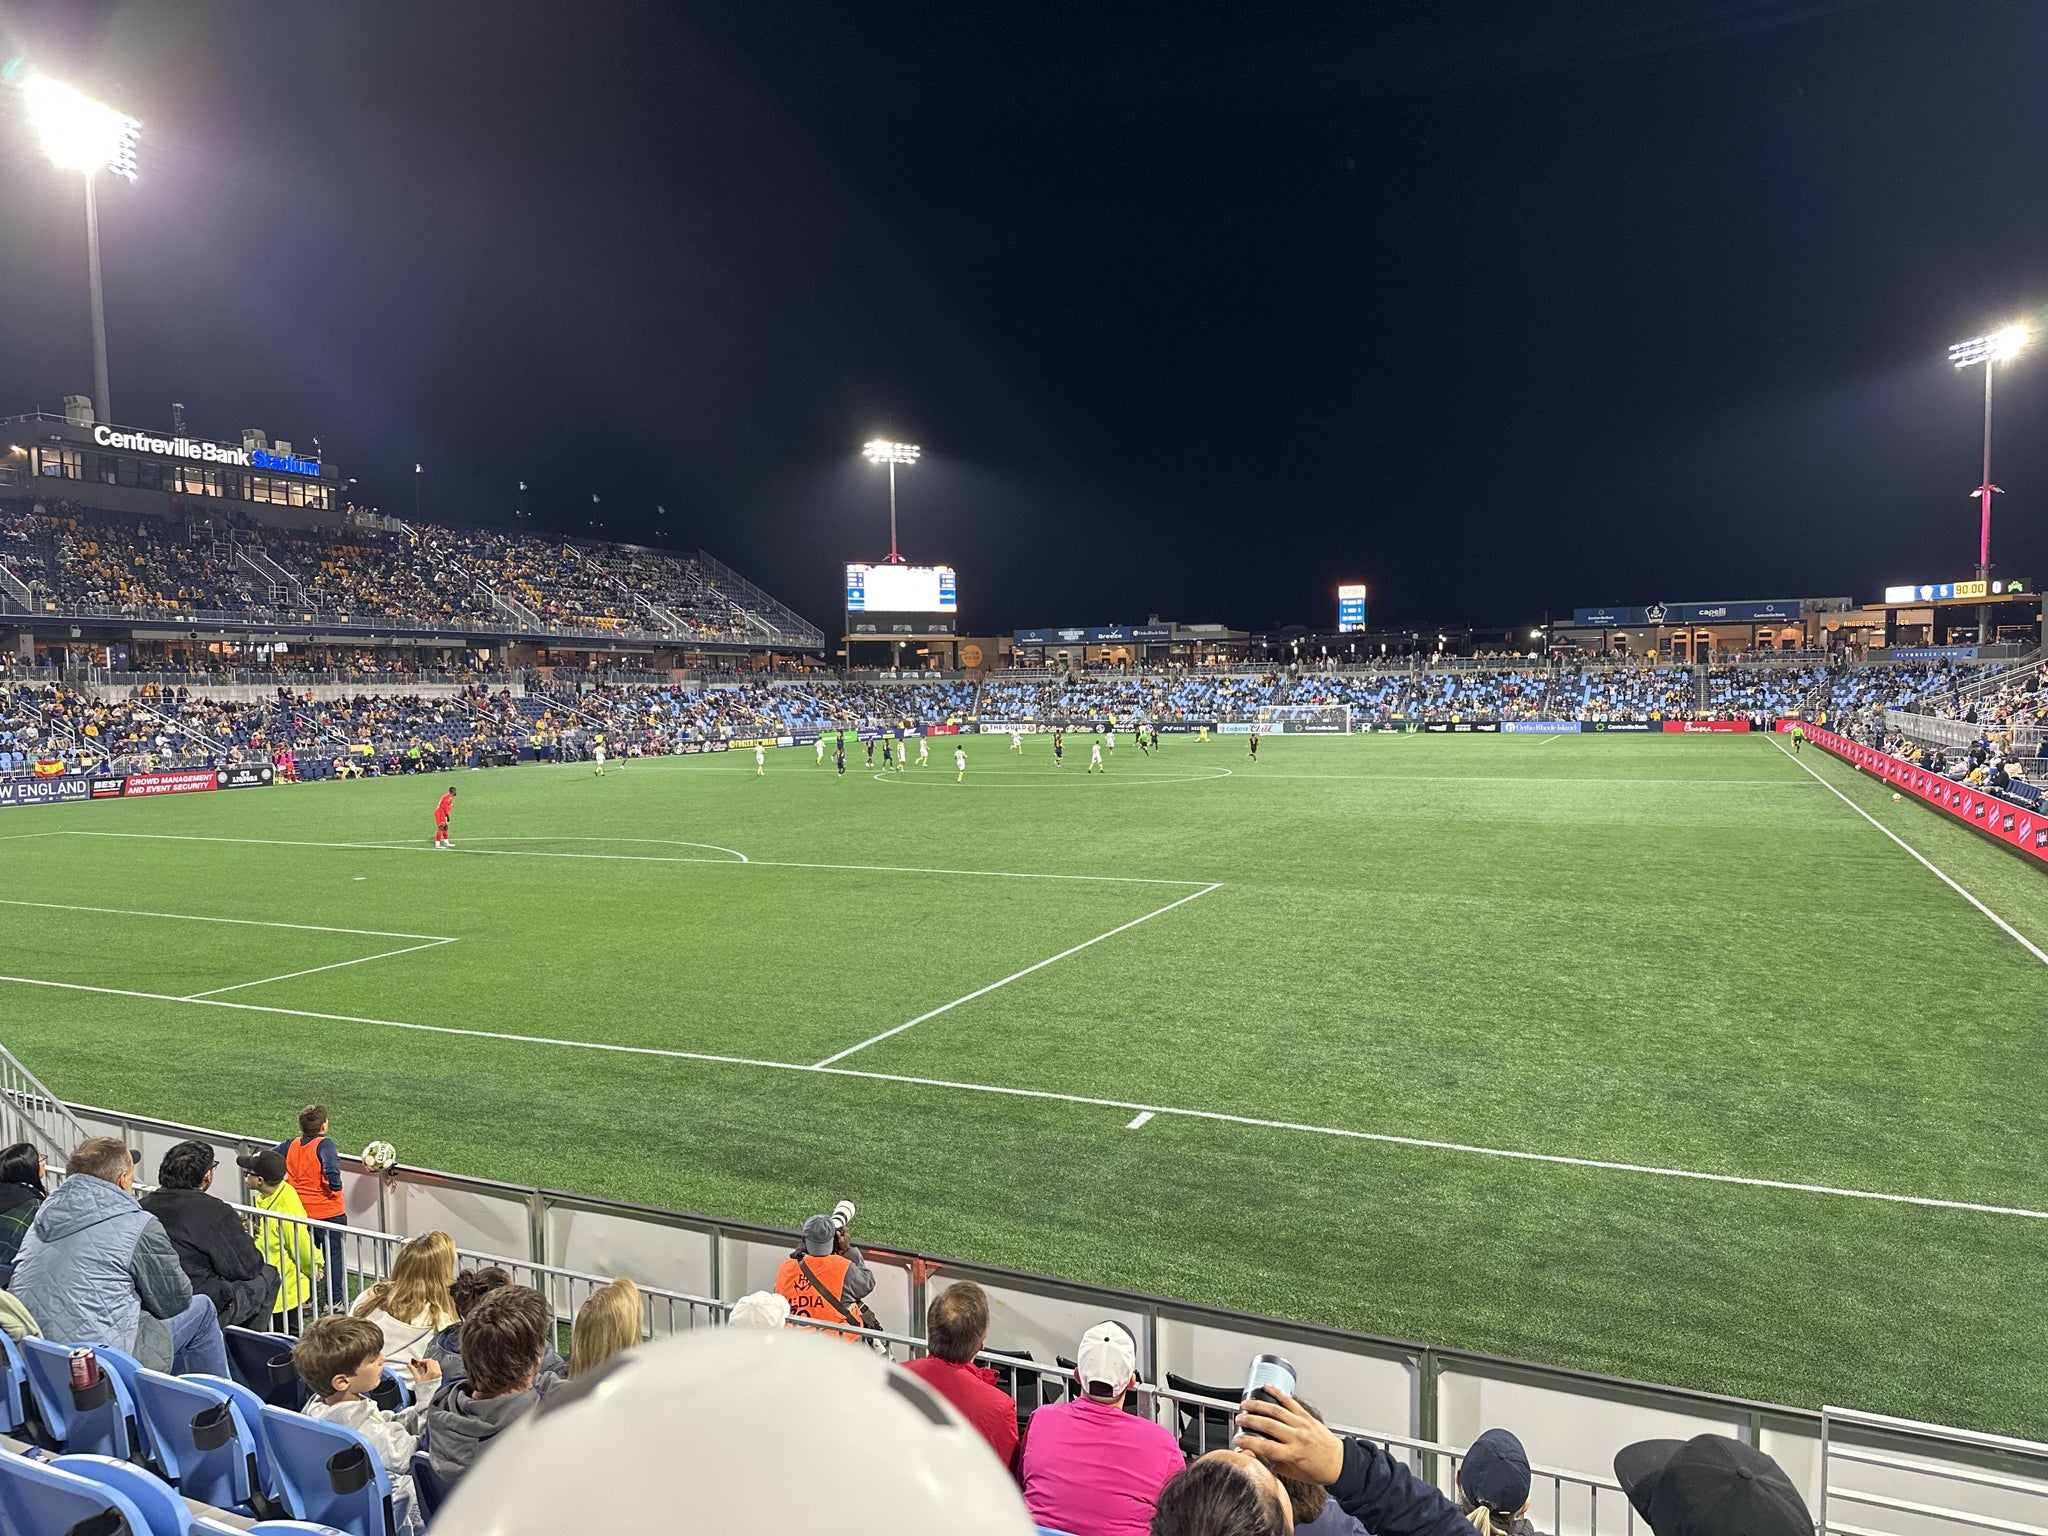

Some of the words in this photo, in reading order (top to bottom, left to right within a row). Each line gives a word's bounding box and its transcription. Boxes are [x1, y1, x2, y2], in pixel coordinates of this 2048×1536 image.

[252, 449, 320, 476] Stadium
[1956, 583, 1984, 595] 90:00
[1558, 723, 1577, 731] Island
[94, 780, 124, 789] BEST
[130, 778, 159, 786] CROWD
[161, 774, 214, 784] MANAGEMENT
[18, 781, 87, 798] ENGLAND
[146, 785, 171, 793] EVENT
[173, 782, 209, 791] SECURITY
